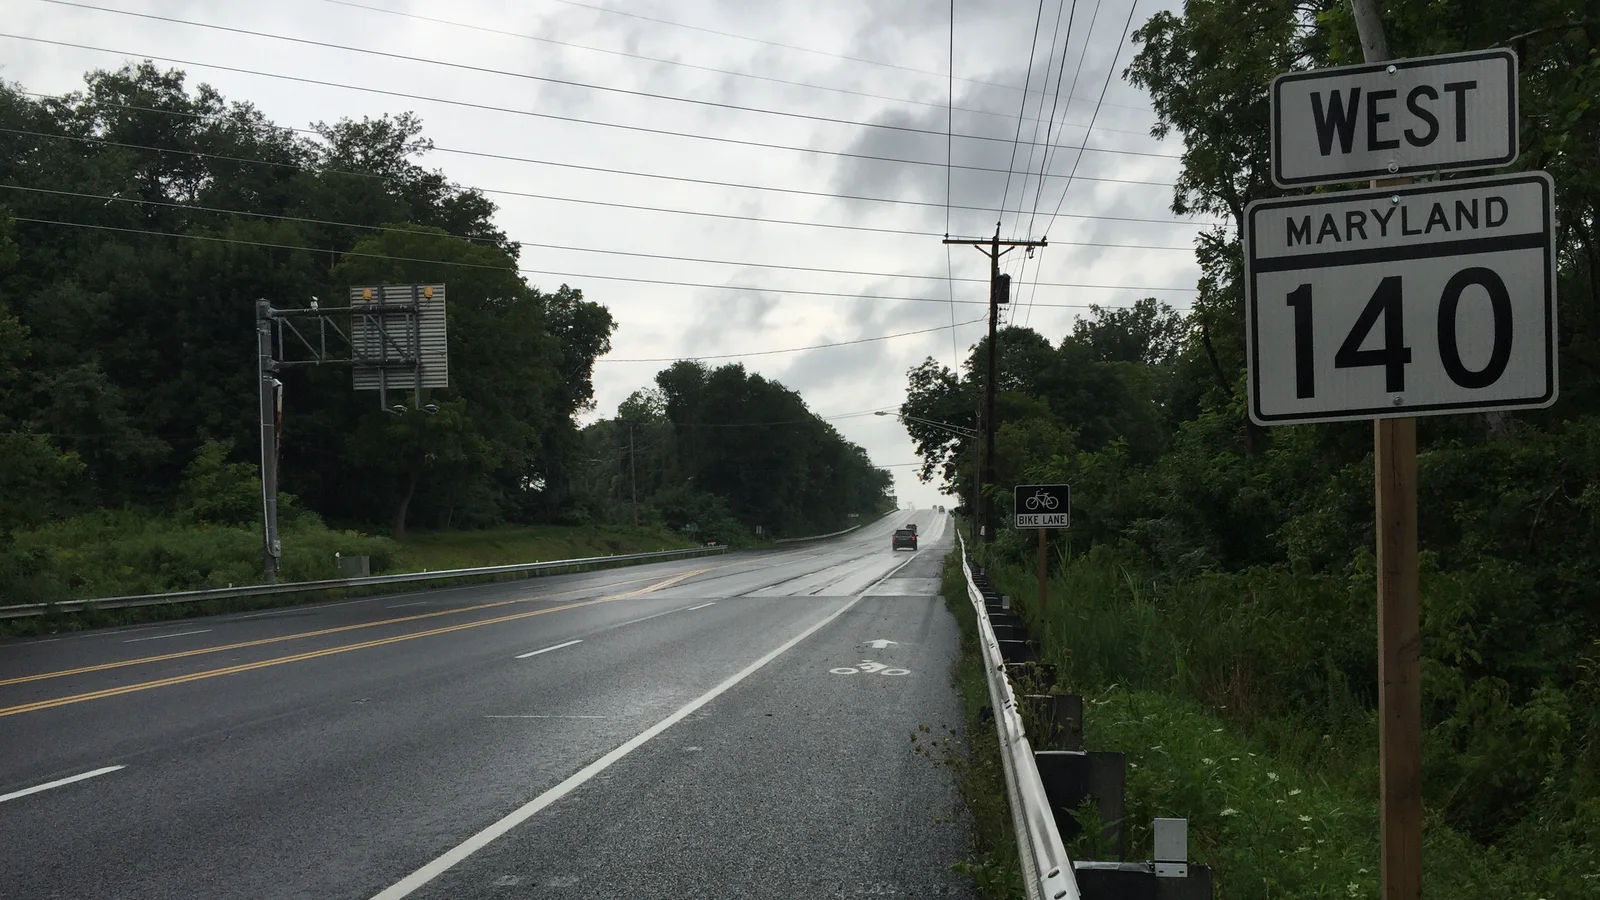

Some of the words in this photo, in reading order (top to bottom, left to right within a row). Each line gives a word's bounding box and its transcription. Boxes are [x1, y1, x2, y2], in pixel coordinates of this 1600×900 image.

[1310, 81, 1477, 156] WEST
[1286, 196, 1509, 247] MARYLAND
[1286, 267, 1513, 399] 140
[1019, 515, 1039, 525] BIKE
[1042, 515, 1066, 525] LANE
